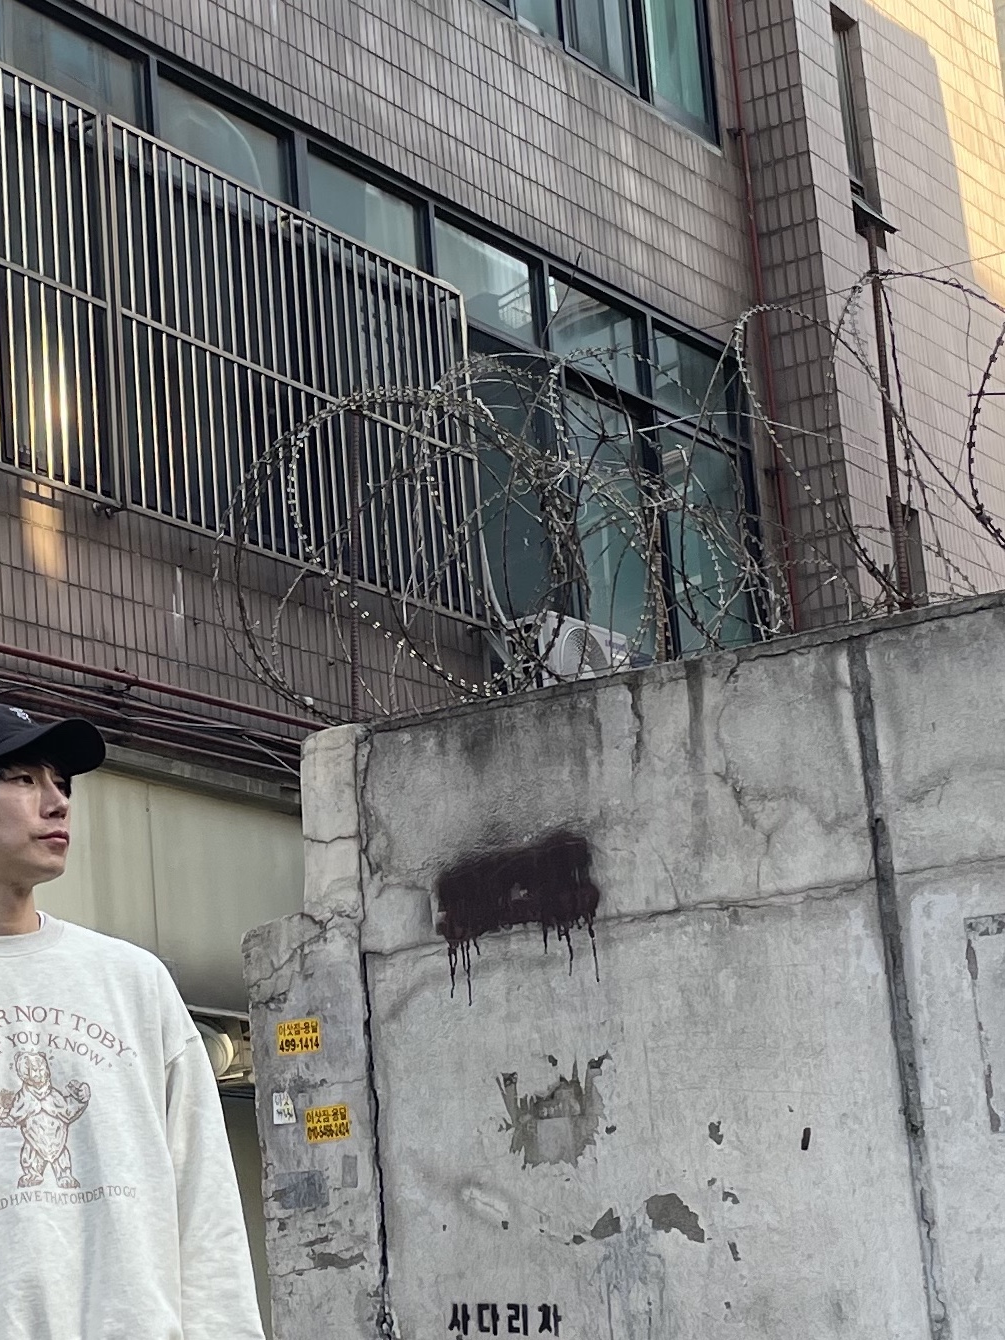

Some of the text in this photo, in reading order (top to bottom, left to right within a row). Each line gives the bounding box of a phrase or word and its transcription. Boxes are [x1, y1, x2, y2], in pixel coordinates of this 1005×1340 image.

[13, 1005, 64, 1025] NOT
[5, 1031, 40, 1048] YOU
[279, 1036, 319, 1052] 499-1414
[9, 1190, 42, 1206] HAVE
[43, 1191, 69, 1205] THAT
[69, 1186, 105, 1205] ORDER
[107, 1185, 122, 1197] TO
